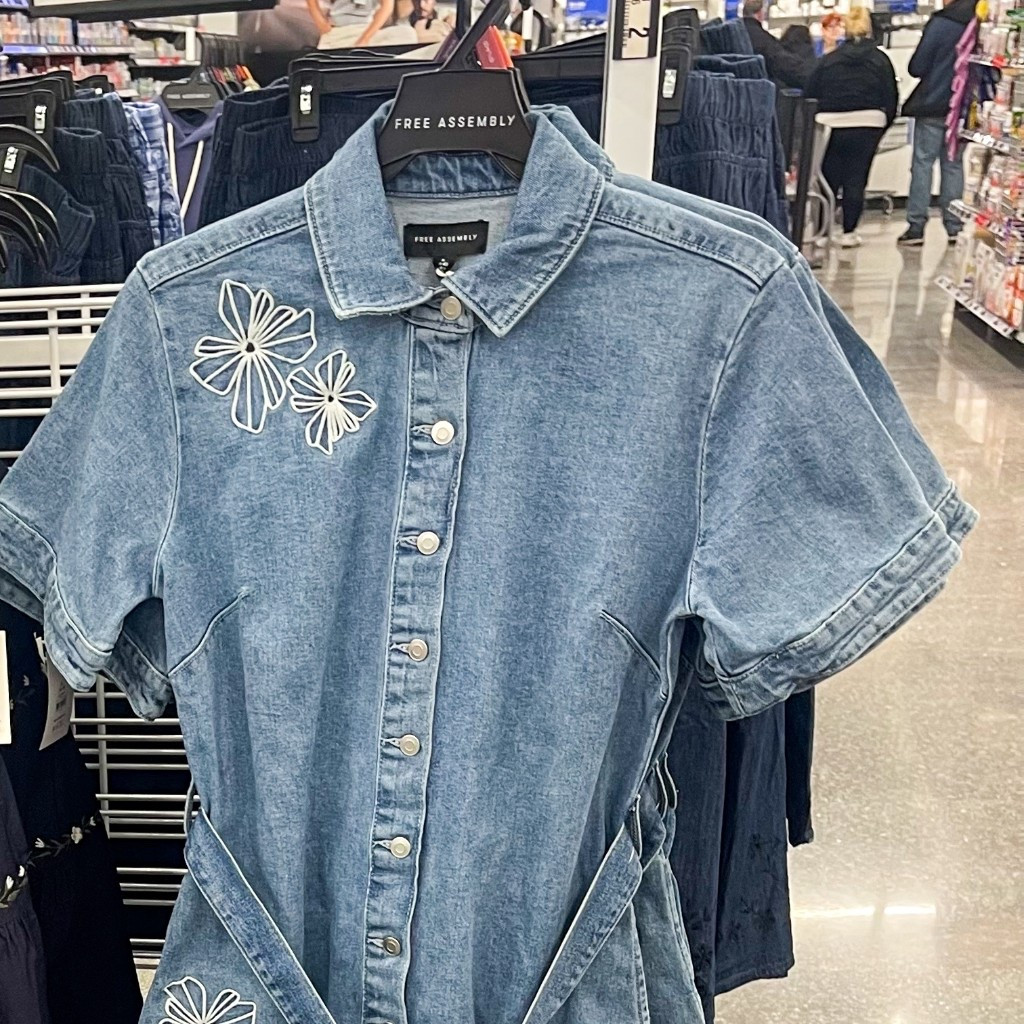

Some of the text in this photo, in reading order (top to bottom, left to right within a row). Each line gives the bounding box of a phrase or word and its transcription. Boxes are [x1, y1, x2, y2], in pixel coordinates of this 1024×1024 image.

[395, 115, 516, 129] FREE ASSEMBLY
[436, 234, 478, 243] ASSEMBLY
